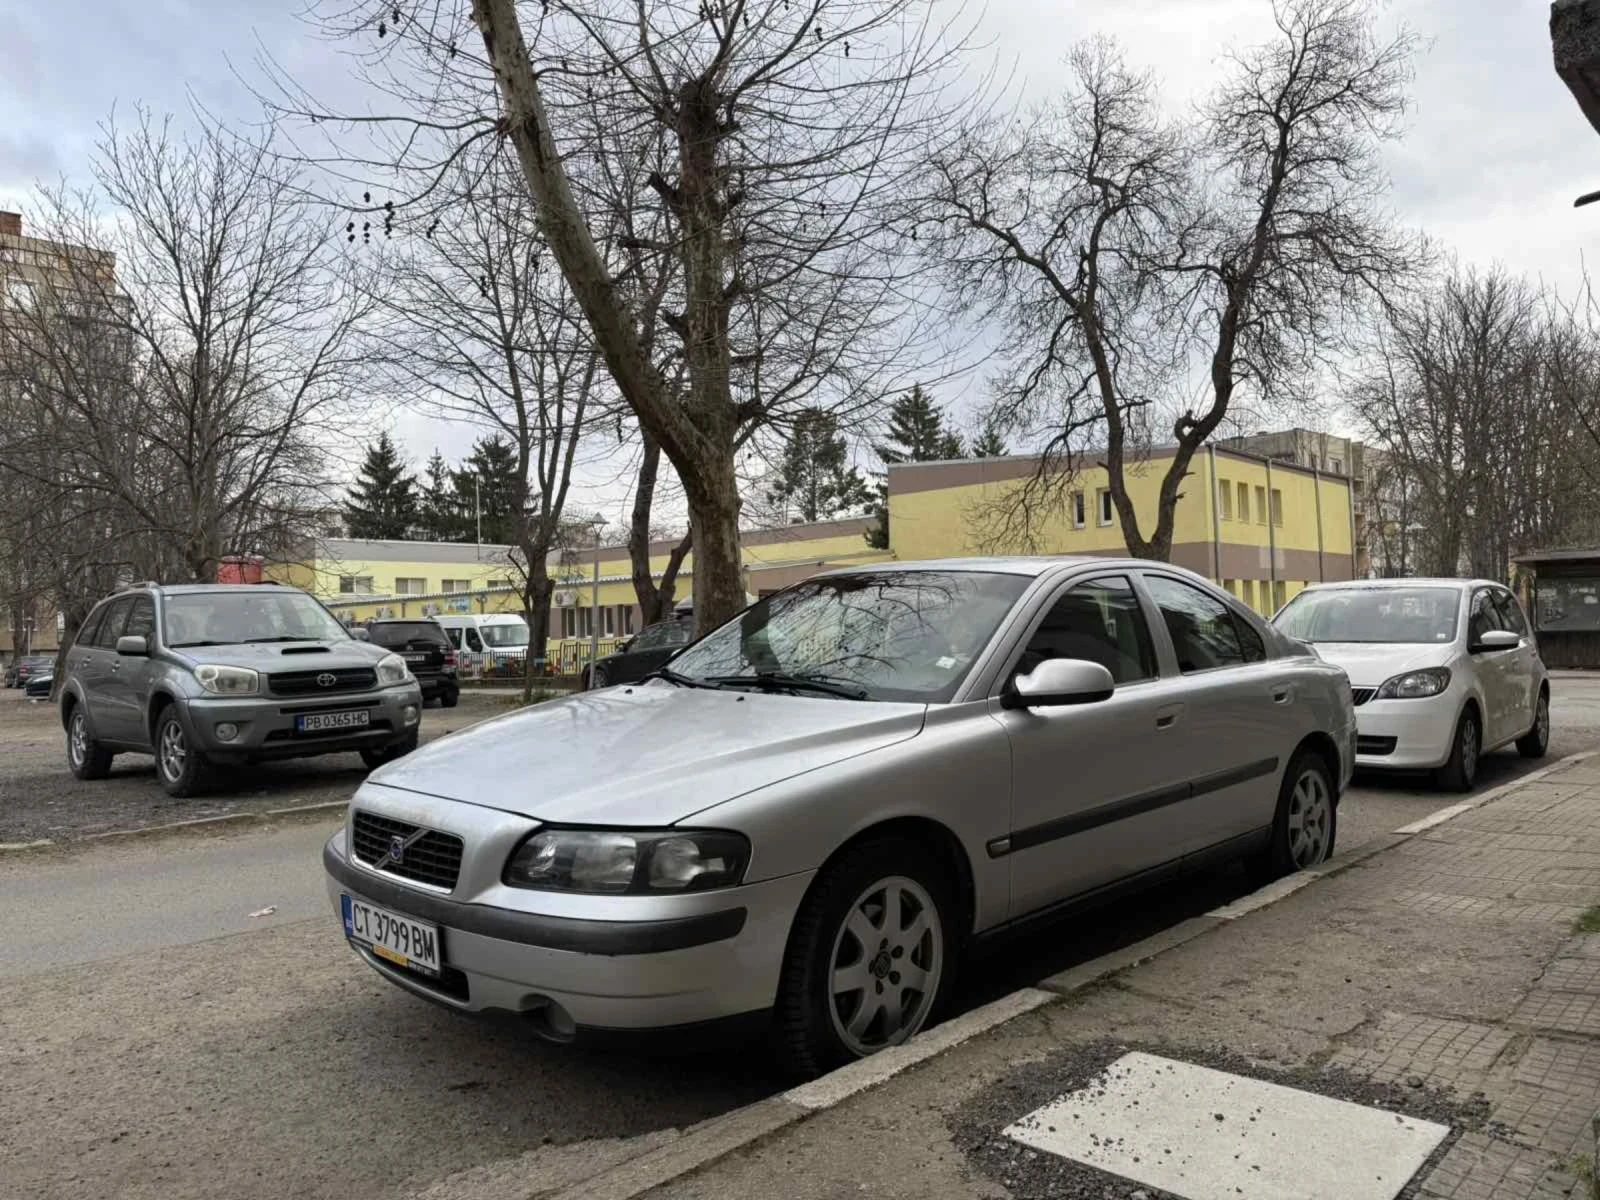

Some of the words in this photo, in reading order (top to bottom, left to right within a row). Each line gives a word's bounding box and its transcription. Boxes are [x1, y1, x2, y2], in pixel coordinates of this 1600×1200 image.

[306, 717, 321, 729] PB
[323, 714, 352, 727] 0365
[352, 712, 367, 725] HC
[353, 903, 371, 937] CT
[374, 911, 410, 954] 3799
[411, 925, 436, 964] BM
